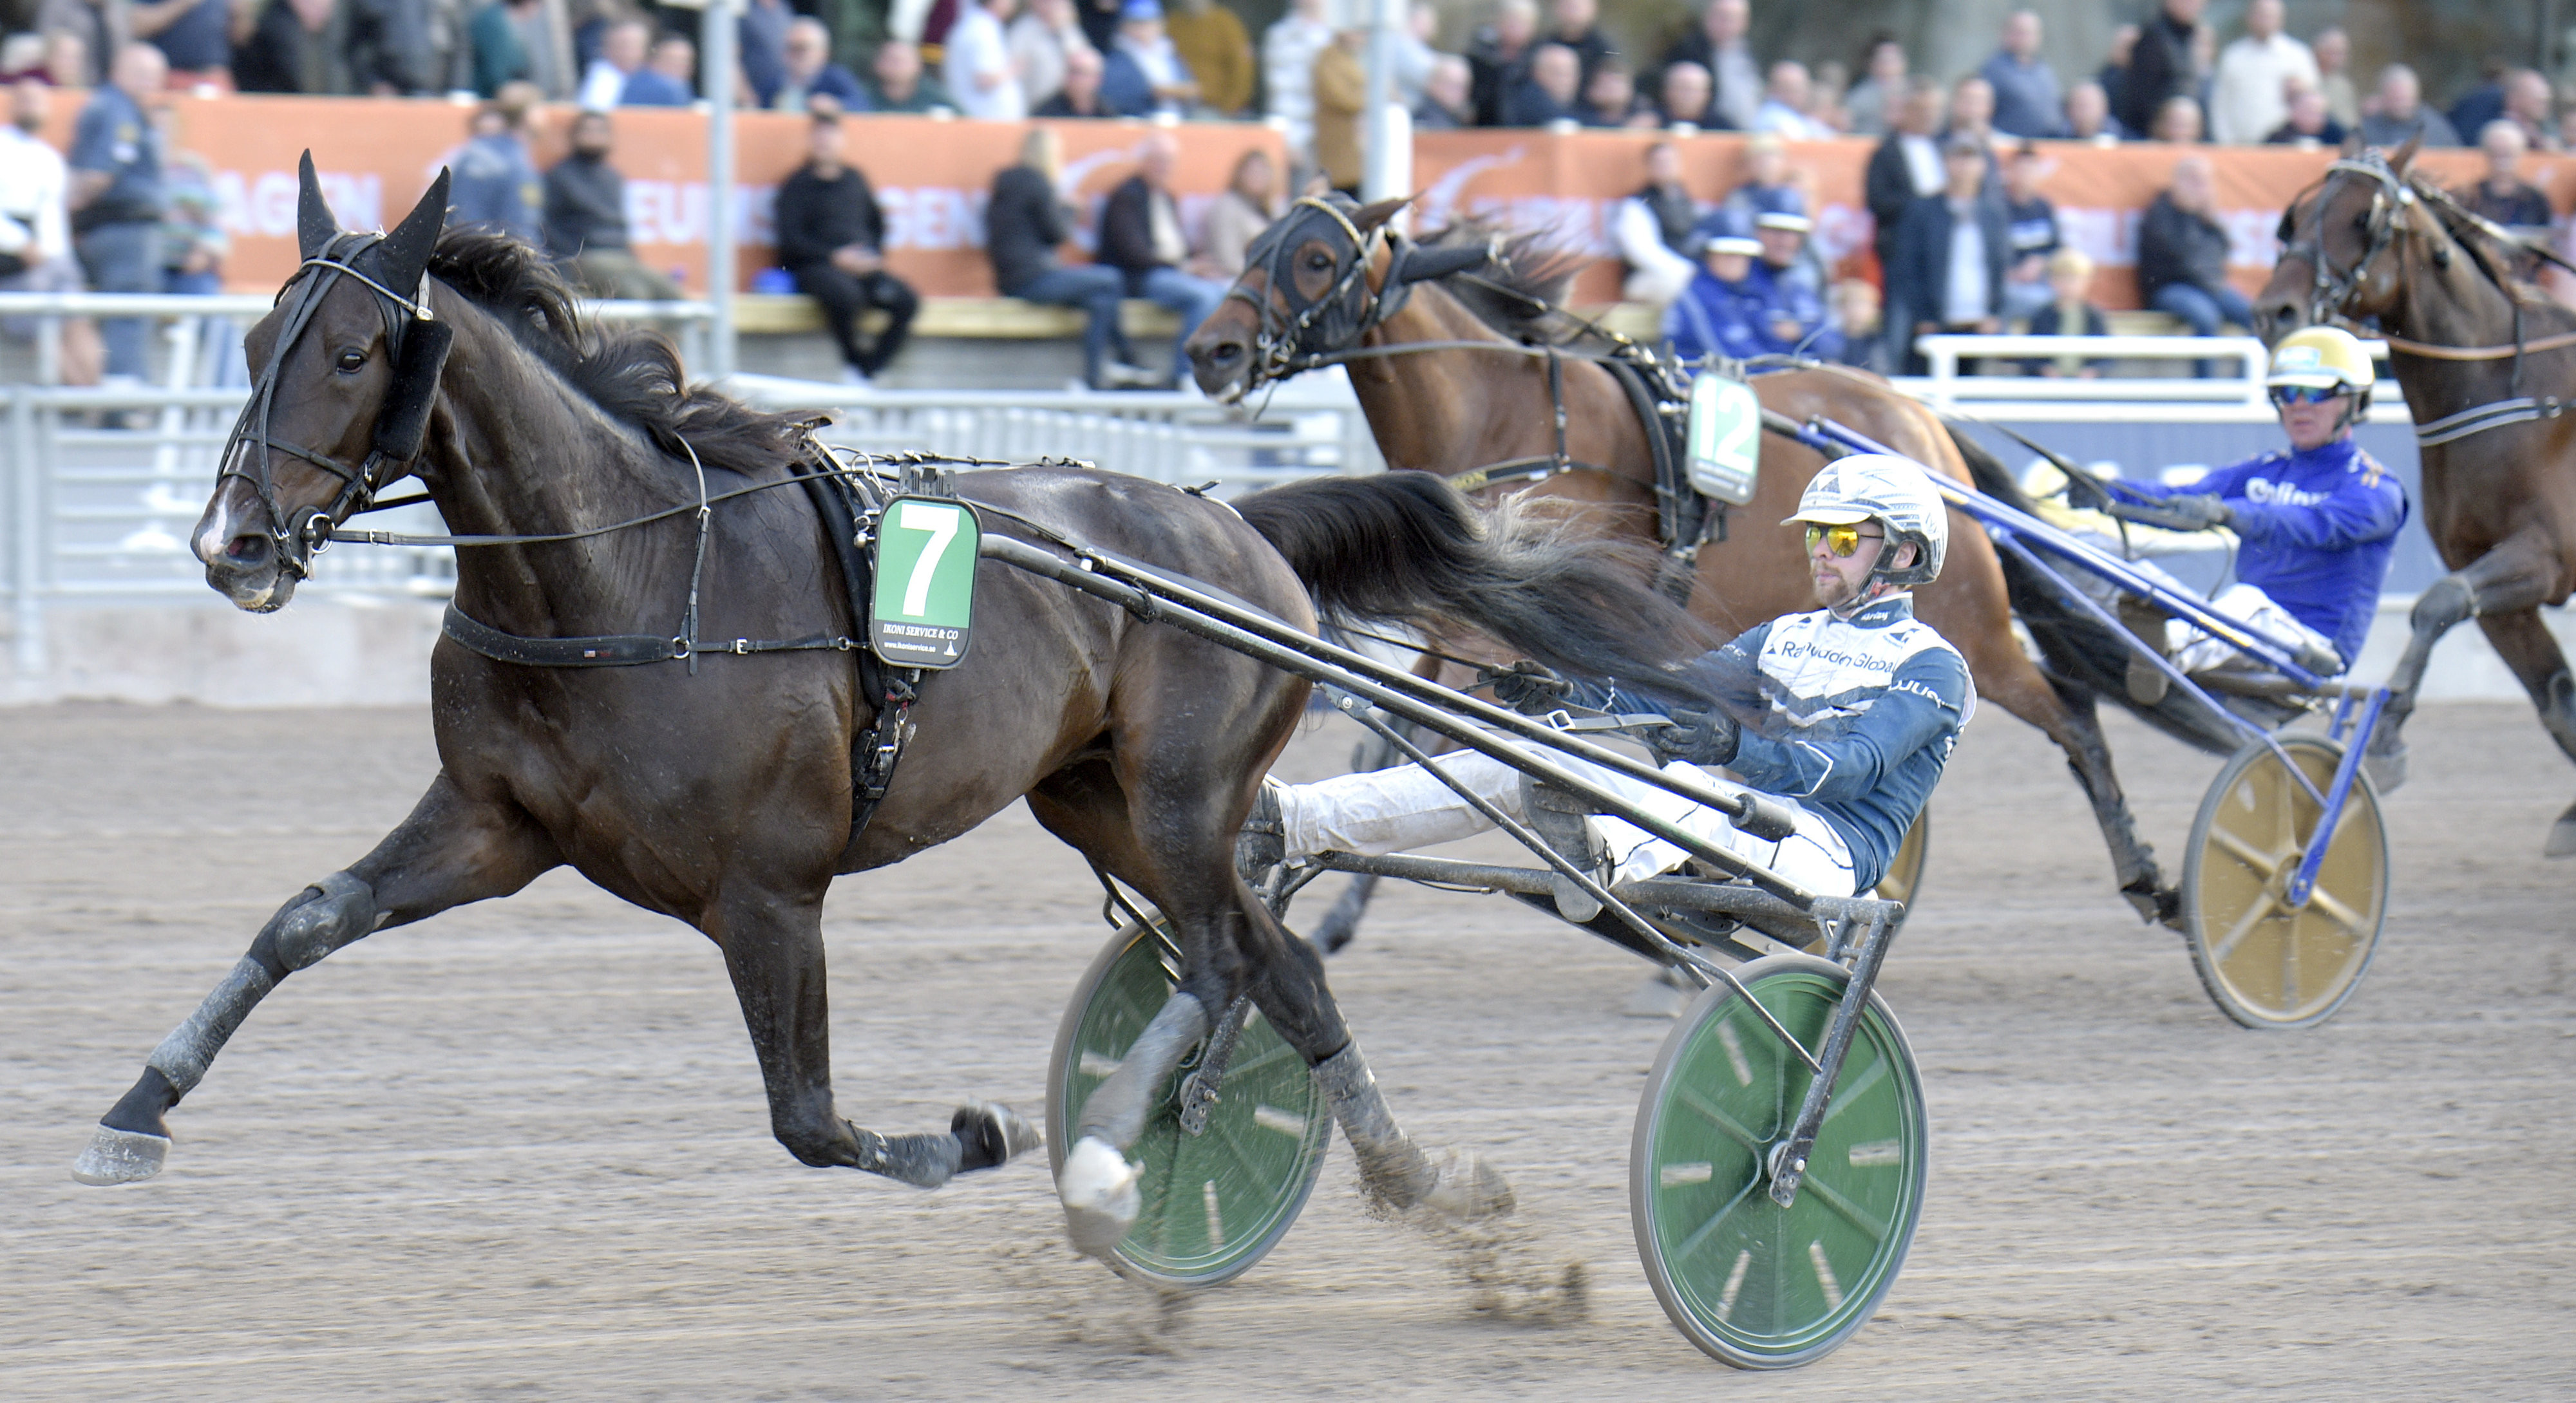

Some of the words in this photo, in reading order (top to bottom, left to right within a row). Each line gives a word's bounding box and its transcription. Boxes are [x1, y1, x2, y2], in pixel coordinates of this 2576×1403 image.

[1694, 377, 1757, 475] 12
[900, 503, 960, 617] 7
[883, 623, 905, 635] IKONI
[905, 625, 938, 638] SERVICE
[938, 629, 945, 639] &
[947, 630, 959, 640] CO
[884, 641, 936, 652] www.ikoniservice.se
